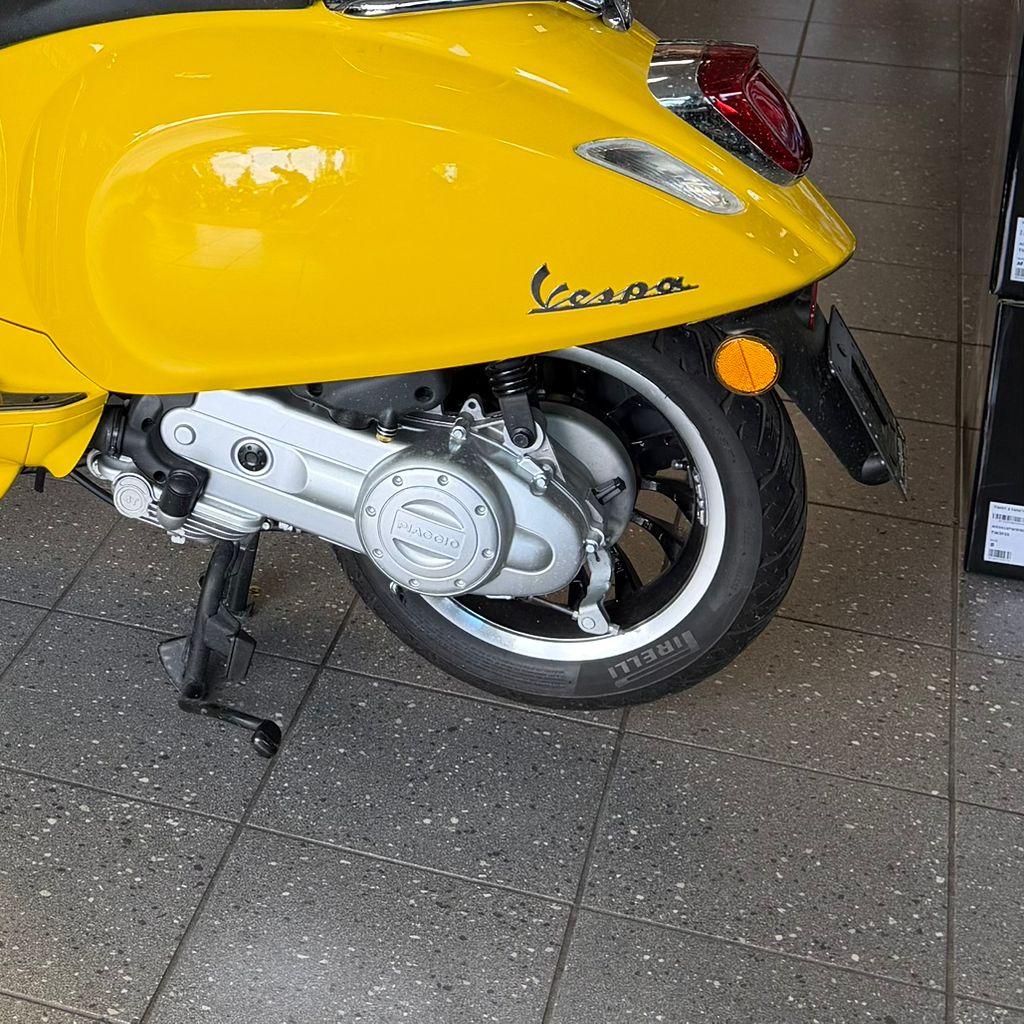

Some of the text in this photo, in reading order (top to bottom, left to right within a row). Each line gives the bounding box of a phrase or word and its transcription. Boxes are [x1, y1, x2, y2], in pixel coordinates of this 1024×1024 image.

[528, 263, 699, 314] Vespa
[397, 520, 460, 550] PIAGGIO
[607, 630, 700, 688] PIRELLI
